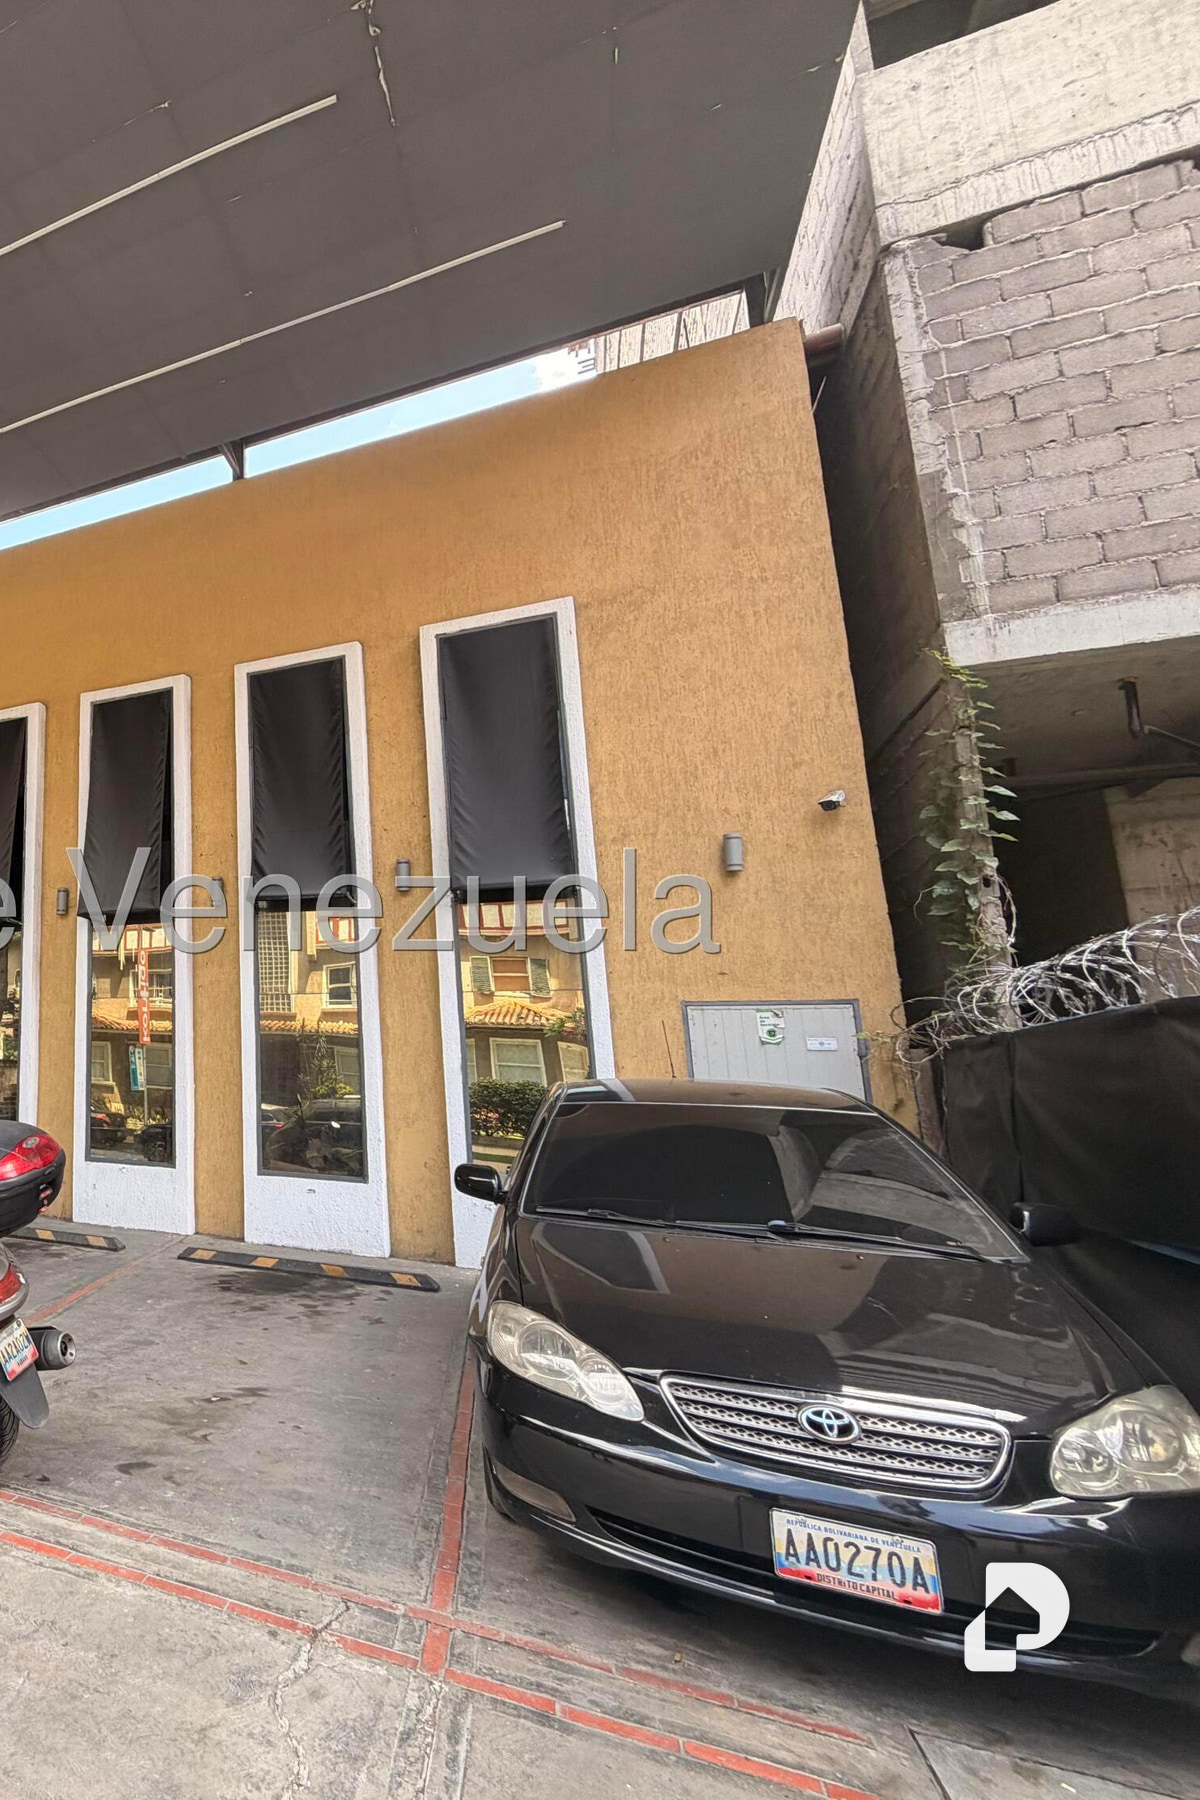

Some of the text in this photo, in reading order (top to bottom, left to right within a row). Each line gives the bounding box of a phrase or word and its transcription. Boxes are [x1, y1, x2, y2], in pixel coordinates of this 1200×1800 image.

[823, 1526, 869, 1543] BOLIVARIANA
[870, 1536, 880, 1544] DE
[881, 1538, 921, 1553] VENEZUELA
[784, 1527, 930, 1595] AA0270A
[816, 1572, 898, 1600] DISTRITO CAPITAL
